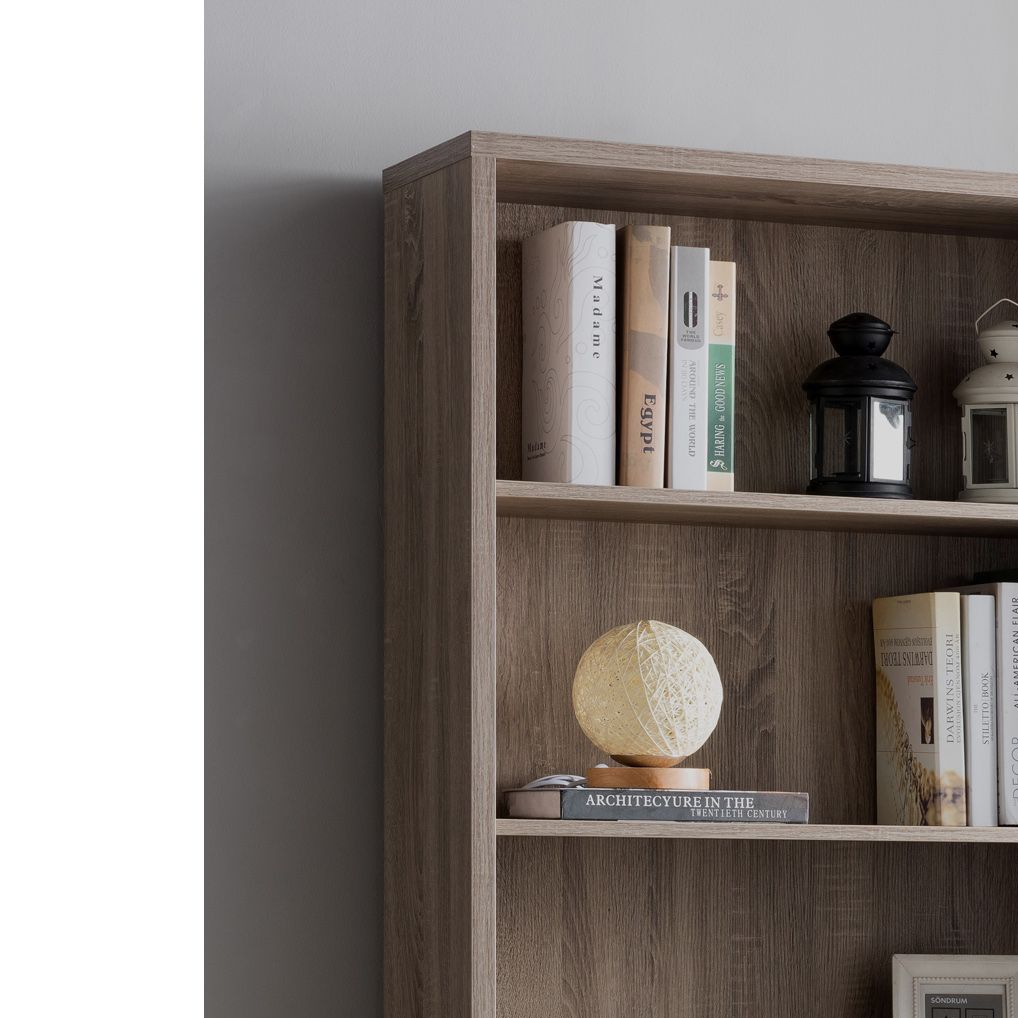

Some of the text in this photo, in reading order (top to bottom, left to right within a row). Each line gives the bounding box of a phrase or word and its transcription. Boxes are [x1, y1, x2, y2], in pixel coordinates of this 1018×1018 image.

[592, 275, 604, 359] Madame
[714, 362, 726, 388] NEWS
[688, 359, 697, 458] AROUND THE WORLD
[714, 388, 726, 412] GOOD
[640, 393, 657, 455] Egypt
[945, 633, 955, 744] DARWINS TEORI
[981, 671, 989, 698] BOOK
[585, 794, 755, 809] ARCHITECYURE IN THE
[690, 808, 788, 819] TWENTIETH CENTURY
